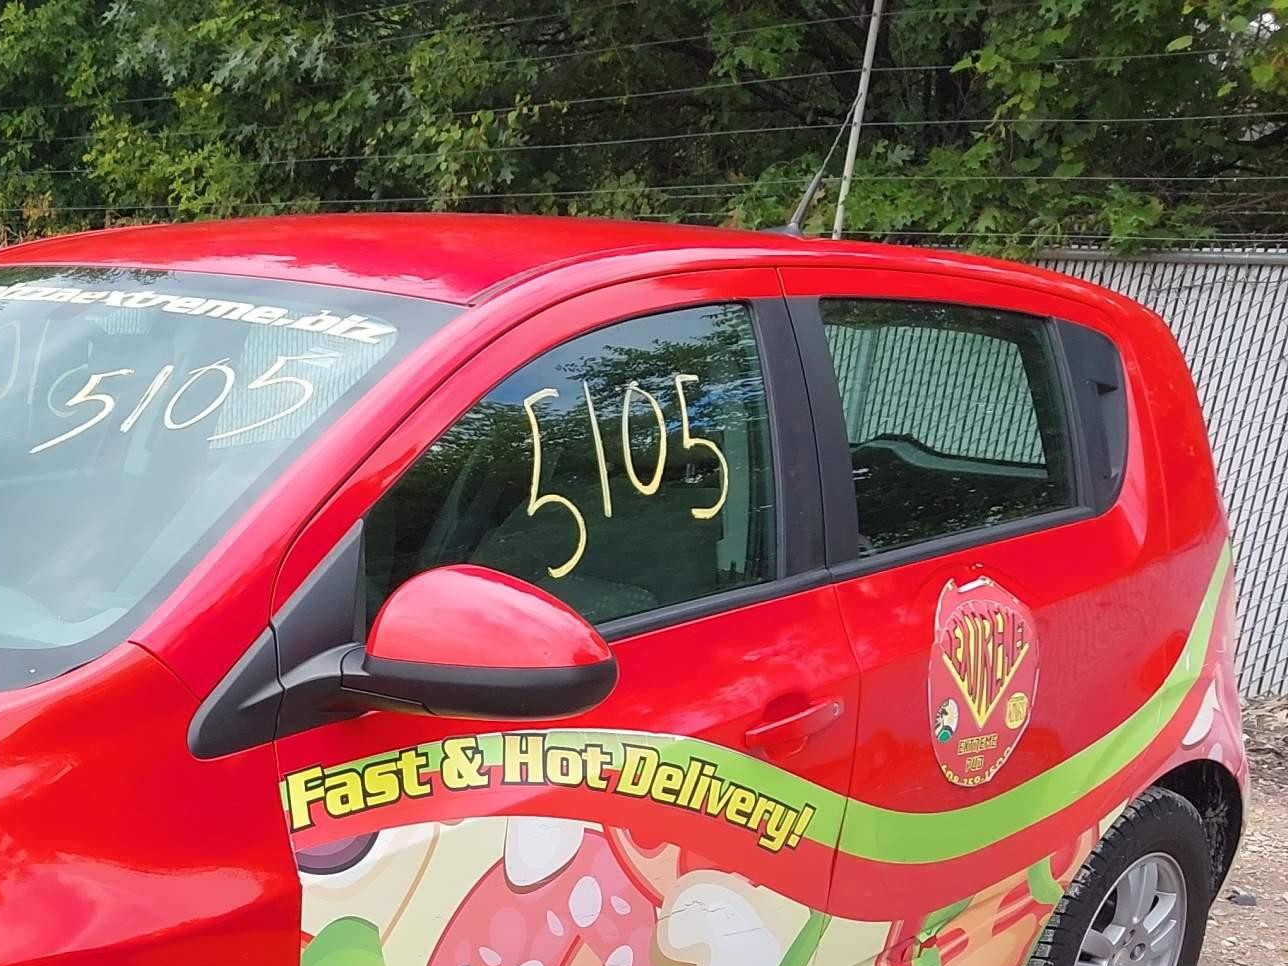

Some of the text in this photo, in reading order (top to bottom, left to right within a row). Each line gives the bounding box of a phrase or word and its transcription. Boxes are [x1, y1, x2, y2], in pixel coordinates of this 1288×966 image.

[29, 353, 334, 454] 5105
[524, 373, 728, 578] 5105
[285, 733, 816, 853] Fast & Hot Delivery!
[957, 733, 998, 755] EXTREME
